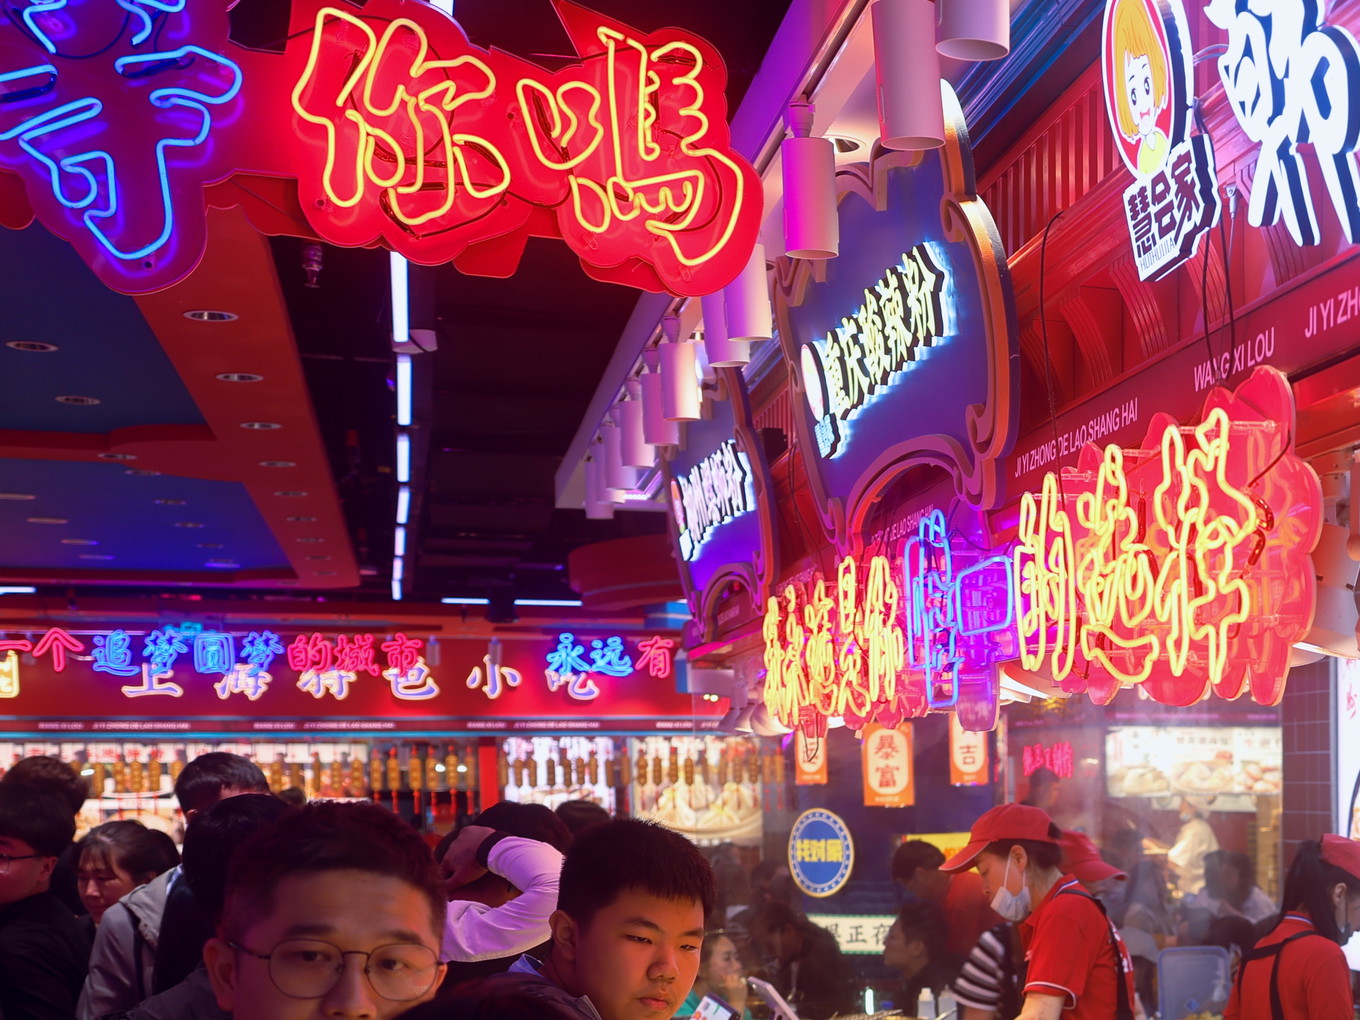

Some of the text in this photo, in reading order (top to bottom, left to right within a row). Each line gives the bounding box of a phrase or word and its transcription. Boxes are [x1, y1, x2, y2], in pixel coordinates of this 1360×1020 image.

[1304, 306, 1318, 339] JI
[1319, 296, 1335, 331] YI
[1232, 343, 1245, 376] XI
[1247, 326, 1275, 367] LOU
[1021, 454, 1030, 474] YI
[1029, 440, 1057, 470] ZHONG
[1069, 426, 1088, 457] LAO
[1088, 409, 1121, 442] SHANG
[1121, 396, 1139, 426] HAI
[873, 734, 900, 789] 暴富
